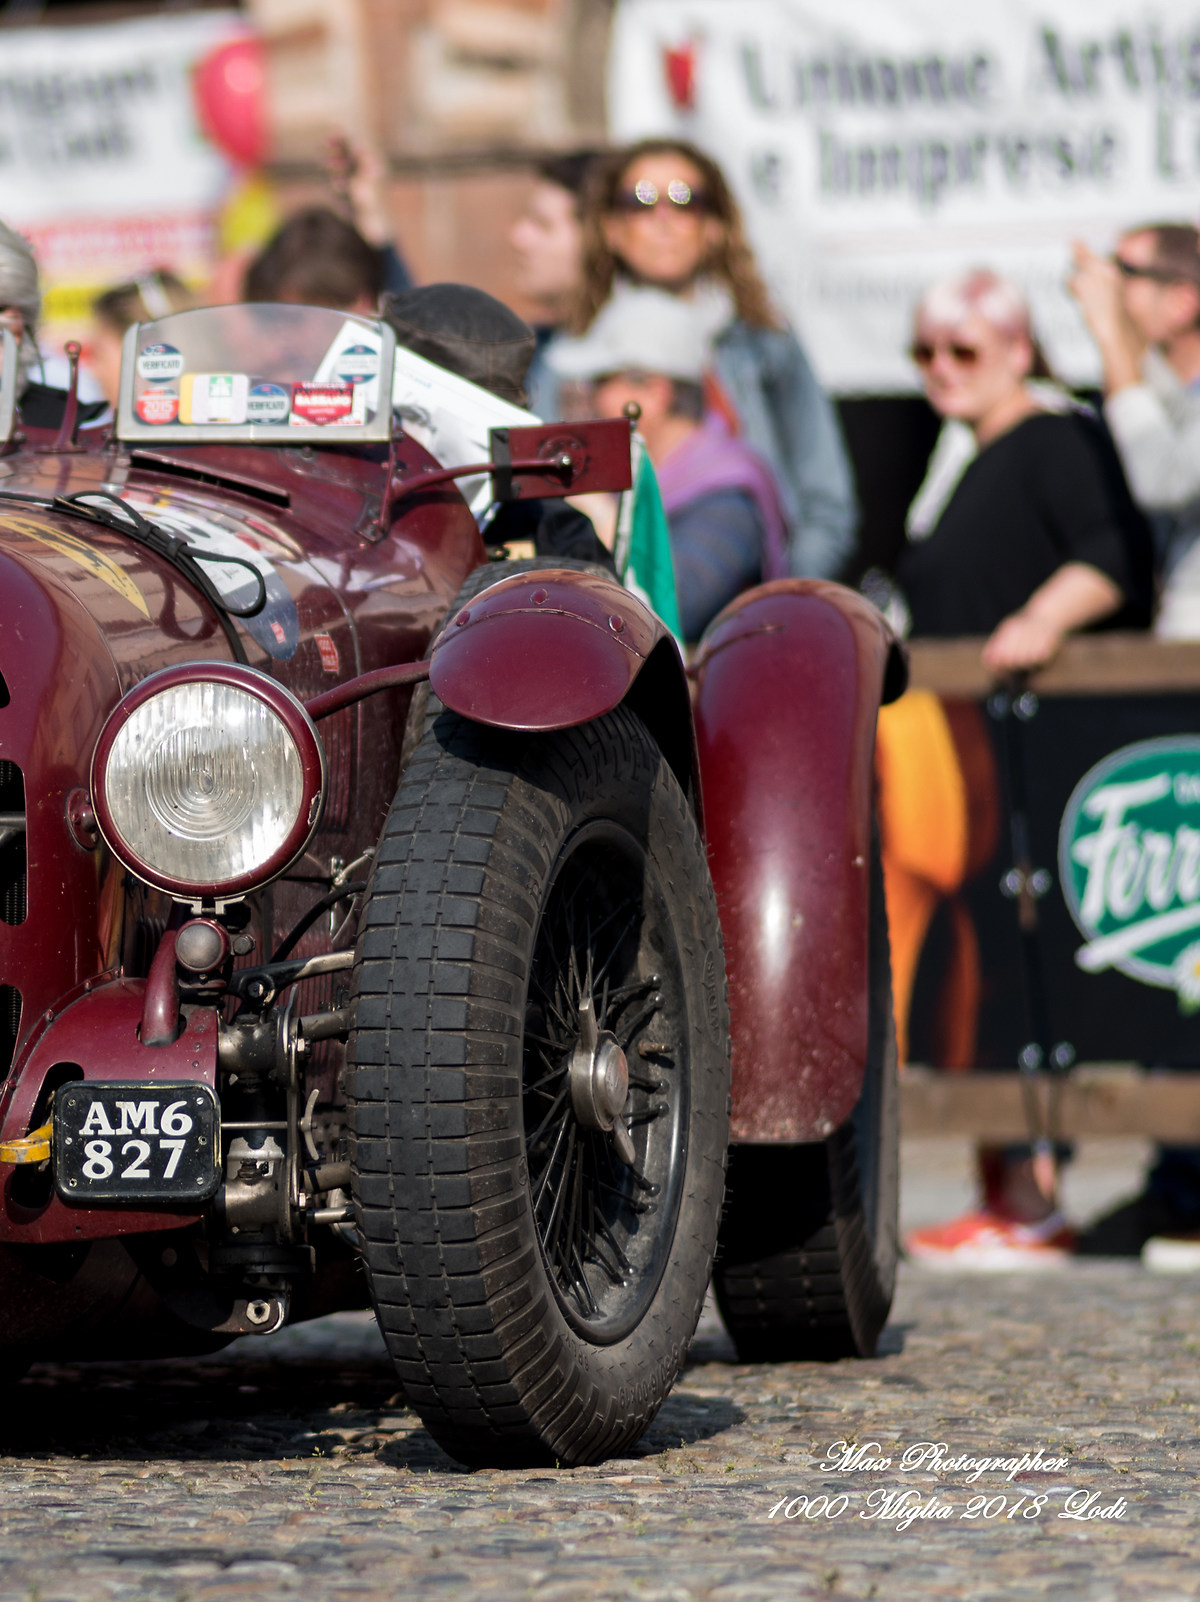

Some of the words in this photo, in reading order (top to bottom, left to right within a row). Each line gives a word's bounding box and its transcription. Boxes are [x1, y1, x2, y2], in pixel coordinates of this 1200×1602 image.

[817, 130, 1117, 218] Imprese
[141, 359, 181, 370] VERIFICATO
[78, 1100, 193, 1137] AM6
[81, 1138, 187, 1179] 827
